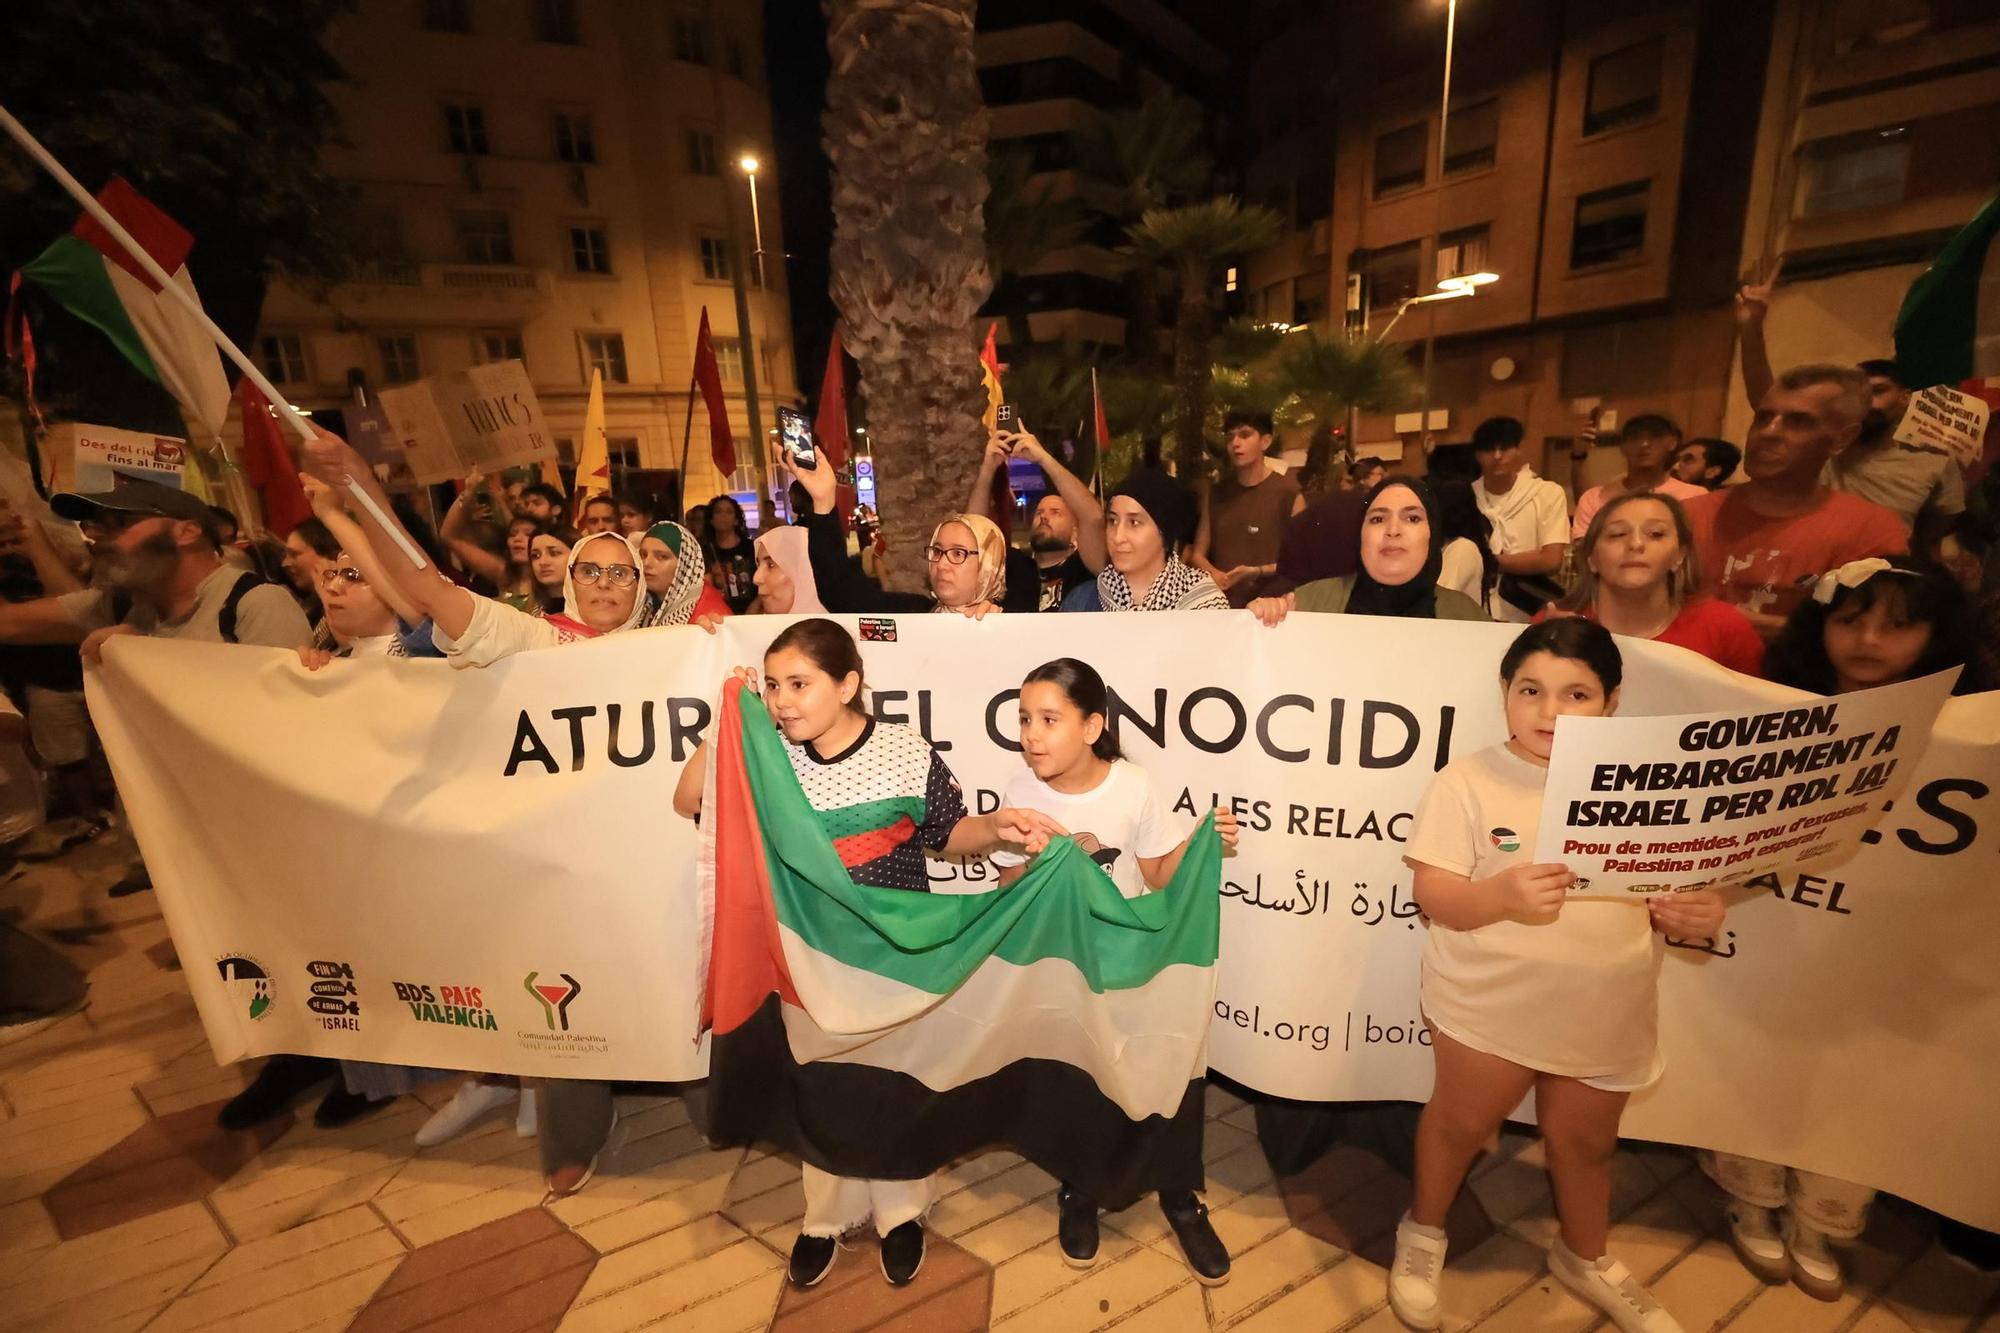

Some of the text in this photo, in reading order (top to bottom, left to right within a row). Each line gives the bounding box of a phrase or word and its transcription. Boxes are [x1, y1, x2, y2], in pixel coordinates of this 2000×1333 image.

[80, 438, 155, 457] Des del riu
[137, 459, 149, 467] al
[152, 461, 177, 471] mar
[503, 697, 712, 777] ATUR
[1679, 703, 1839, 752] GOVERN,
[1590, 725, 1901, 792] EMBARGAMENT A
[1566, 758, 1898, 827] ISRAEL PER RDL JA!
[1172, 786, 1198, 817] A
[1287, 803, 1414, 842] RELAC
[1743, 871, 1852, 914] AEL
[1563, 839, 1611, 855] Prou
[1616, 840, 1642, 855] de
[1646, 834, 1739, 855] mentides,
[1744, 824, 1786, 846] prou
[1602, 858, 1694, 873] Palestina
[1698, 856, 1722, 870] no
[1724, 848, 1755, 867] pot
[1757, 827, 1828, 857] esperar!
[1219, 869, 1330, 916] الأسلح
[1351, 882, 1425, 930] جارة
[313, 963, 331, 976] FIN
[392, 981, 435, 1003] BDS
[322, 1002, 343, 1011] ARMAS
[323, 1017, 360, 1031] ISRAEL
[1213, 1000, 1330, 1051] ael.org
[517, 1031, 606, 1042] Comunidad Palestina
